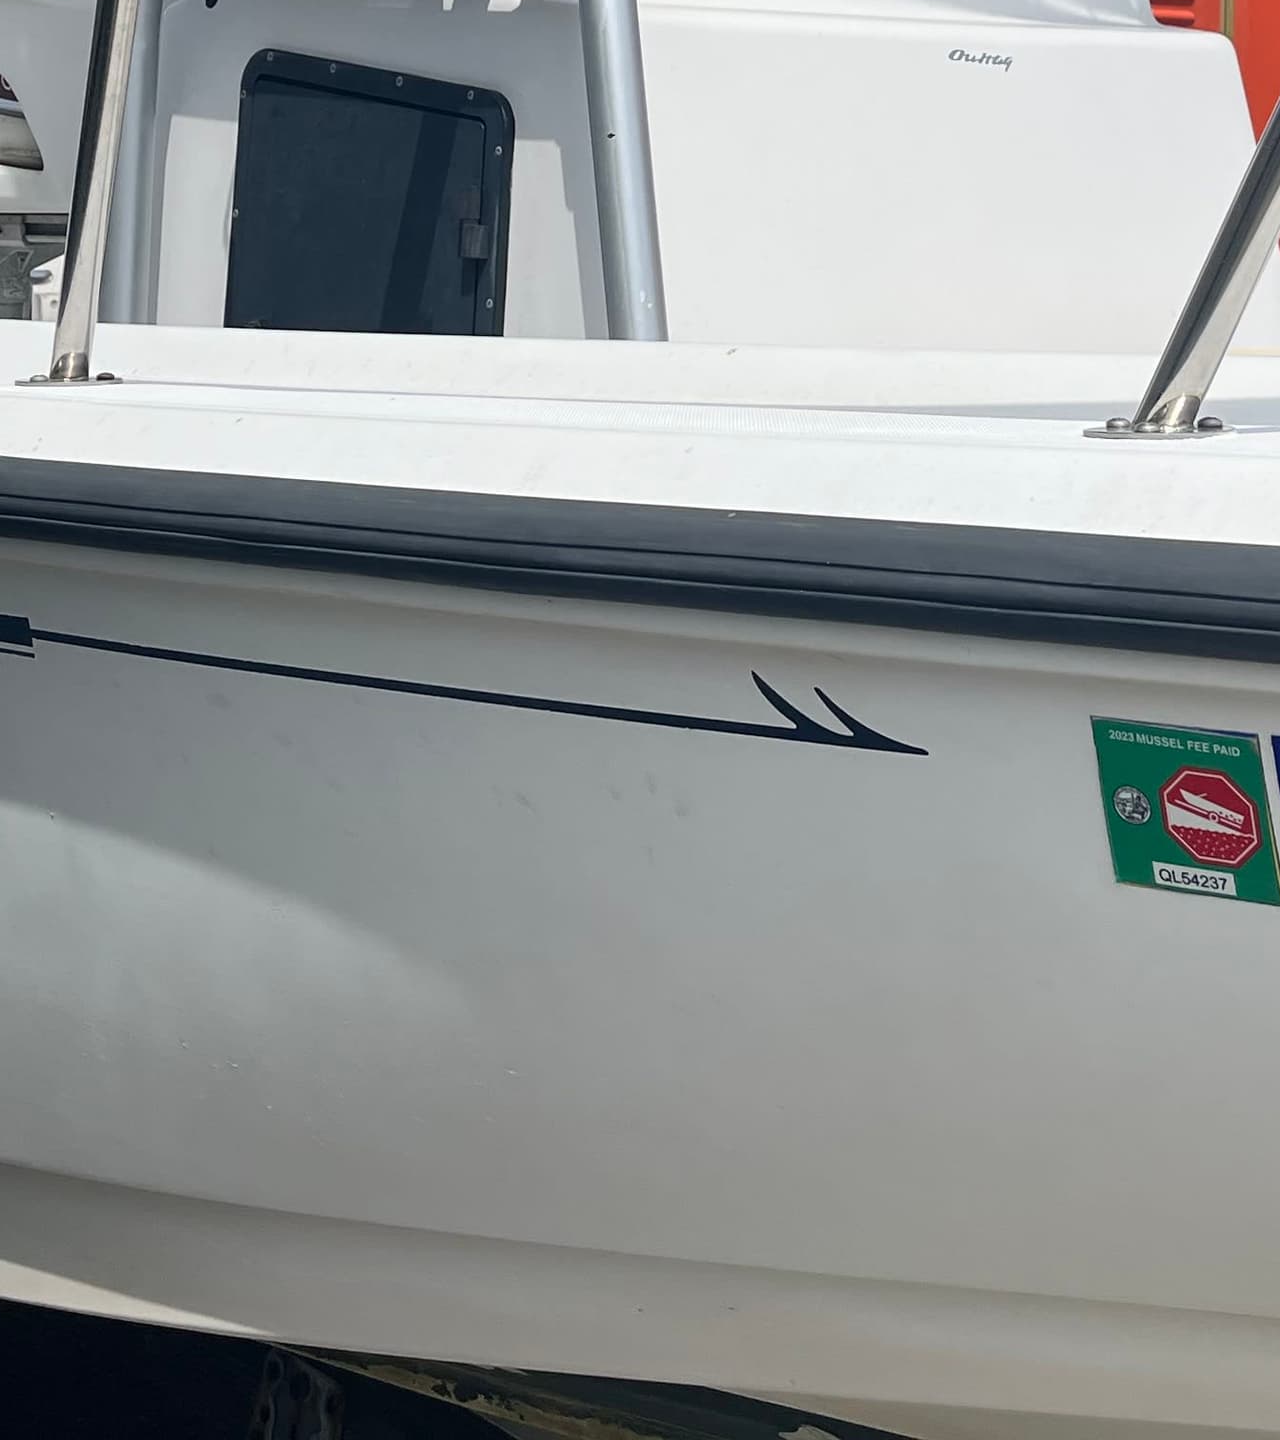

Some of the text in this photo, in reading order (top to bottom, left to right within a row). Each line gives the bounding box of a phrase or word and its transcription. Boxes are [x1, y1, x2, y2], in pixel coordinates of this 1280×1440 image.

[1108, 729, 1241, 758] 2023 MUSSEL FEE PAID
[1158, 867, 1228, 892] QL54237
